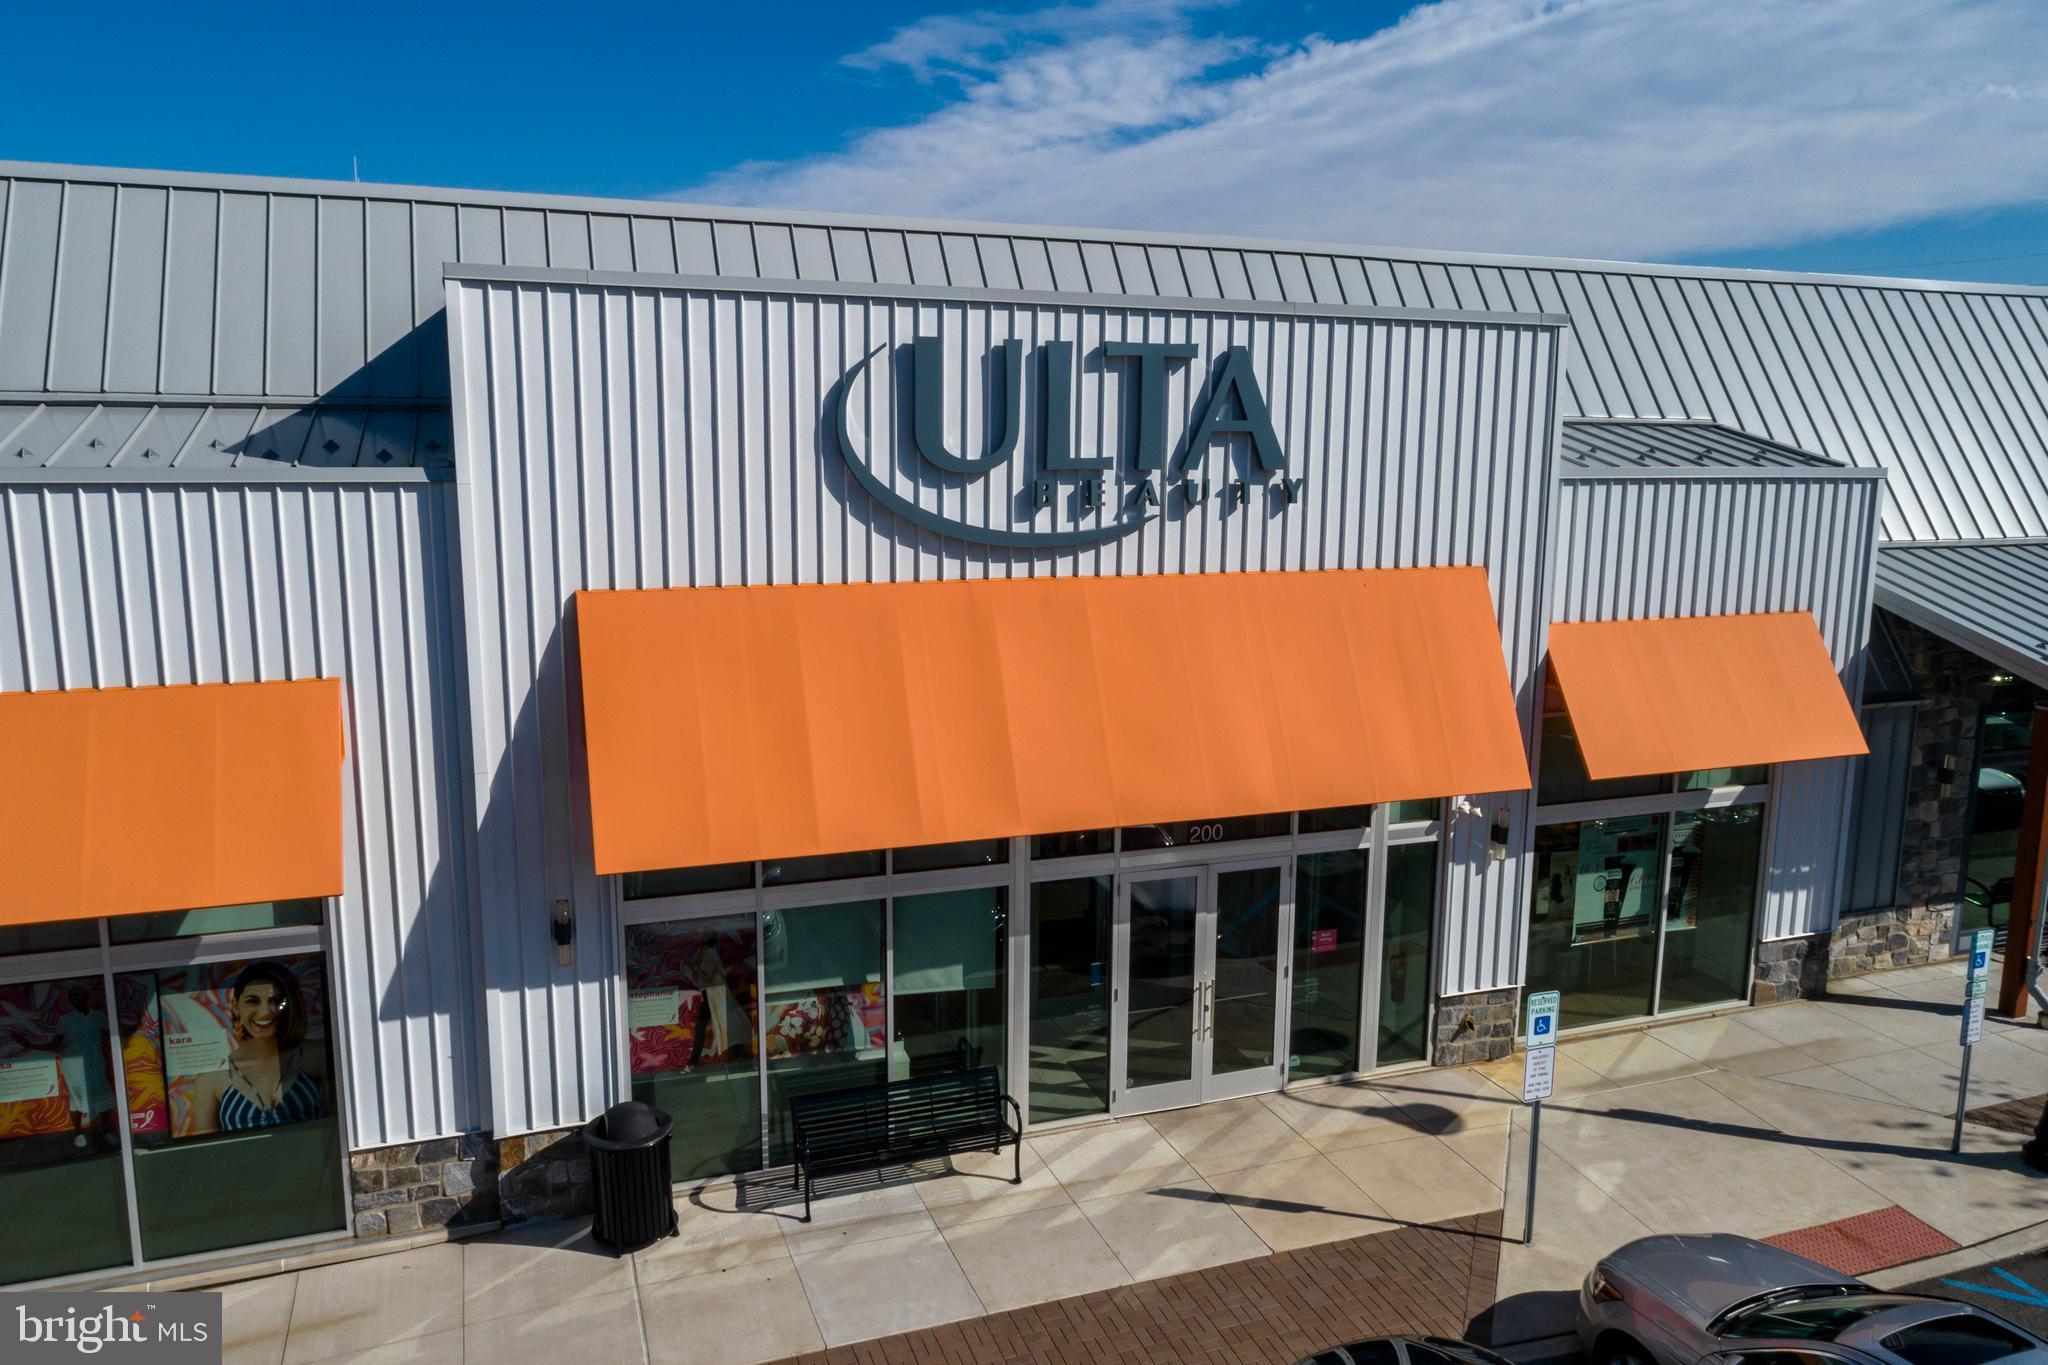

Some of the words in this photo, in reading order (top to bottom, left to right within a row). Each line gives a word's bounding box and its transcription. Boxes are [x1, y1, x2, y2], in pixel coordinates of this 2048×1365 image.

[913, 336, 1286, 473] ULTA
[1033, 477, 1305, 508] BEAUTY
[1190, 824, 1223, 843] 200
[1530, 996, 1557, 1006] RESERVED
[1531, 1006, 1555, 1015] PARKING
[168, 1036, 193, 1045] kara
